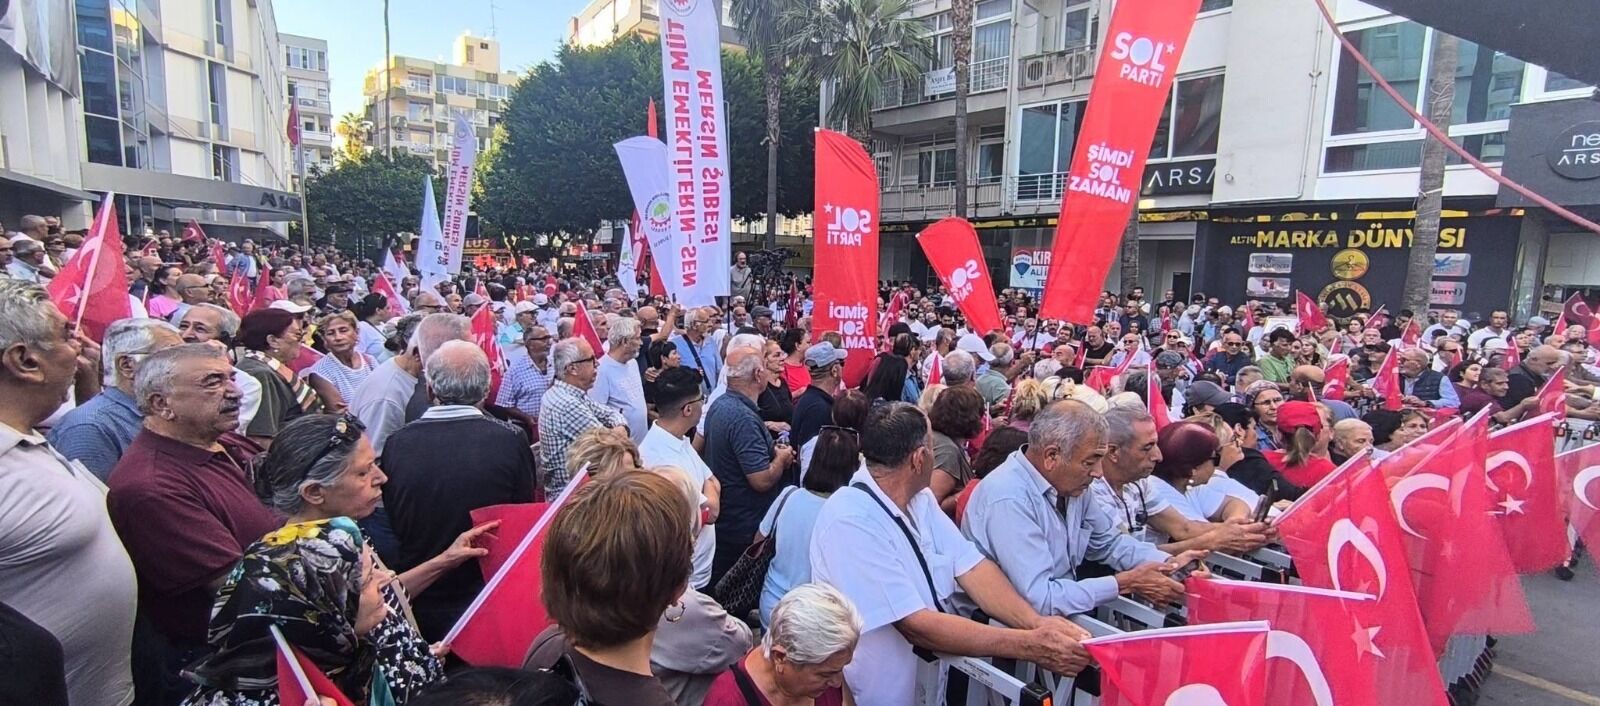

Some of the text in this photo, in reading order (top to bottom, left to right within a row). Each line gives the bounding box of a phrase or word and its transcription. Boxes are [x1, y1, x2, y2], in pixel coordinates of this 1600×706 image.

[1110, 31, 1165, 72] SOL
[1119, 63, 1164, 88] PARTİ
[1087, 142, 1135, 168] ŞİMDİ
[1088, 162, 1121, 184] SOL
[1069, 176, 1131, 204] ZAMANI
[1256, 230, 1339, 248] MARKA
[1347, 223, 1466, 248] DÜNYSI
